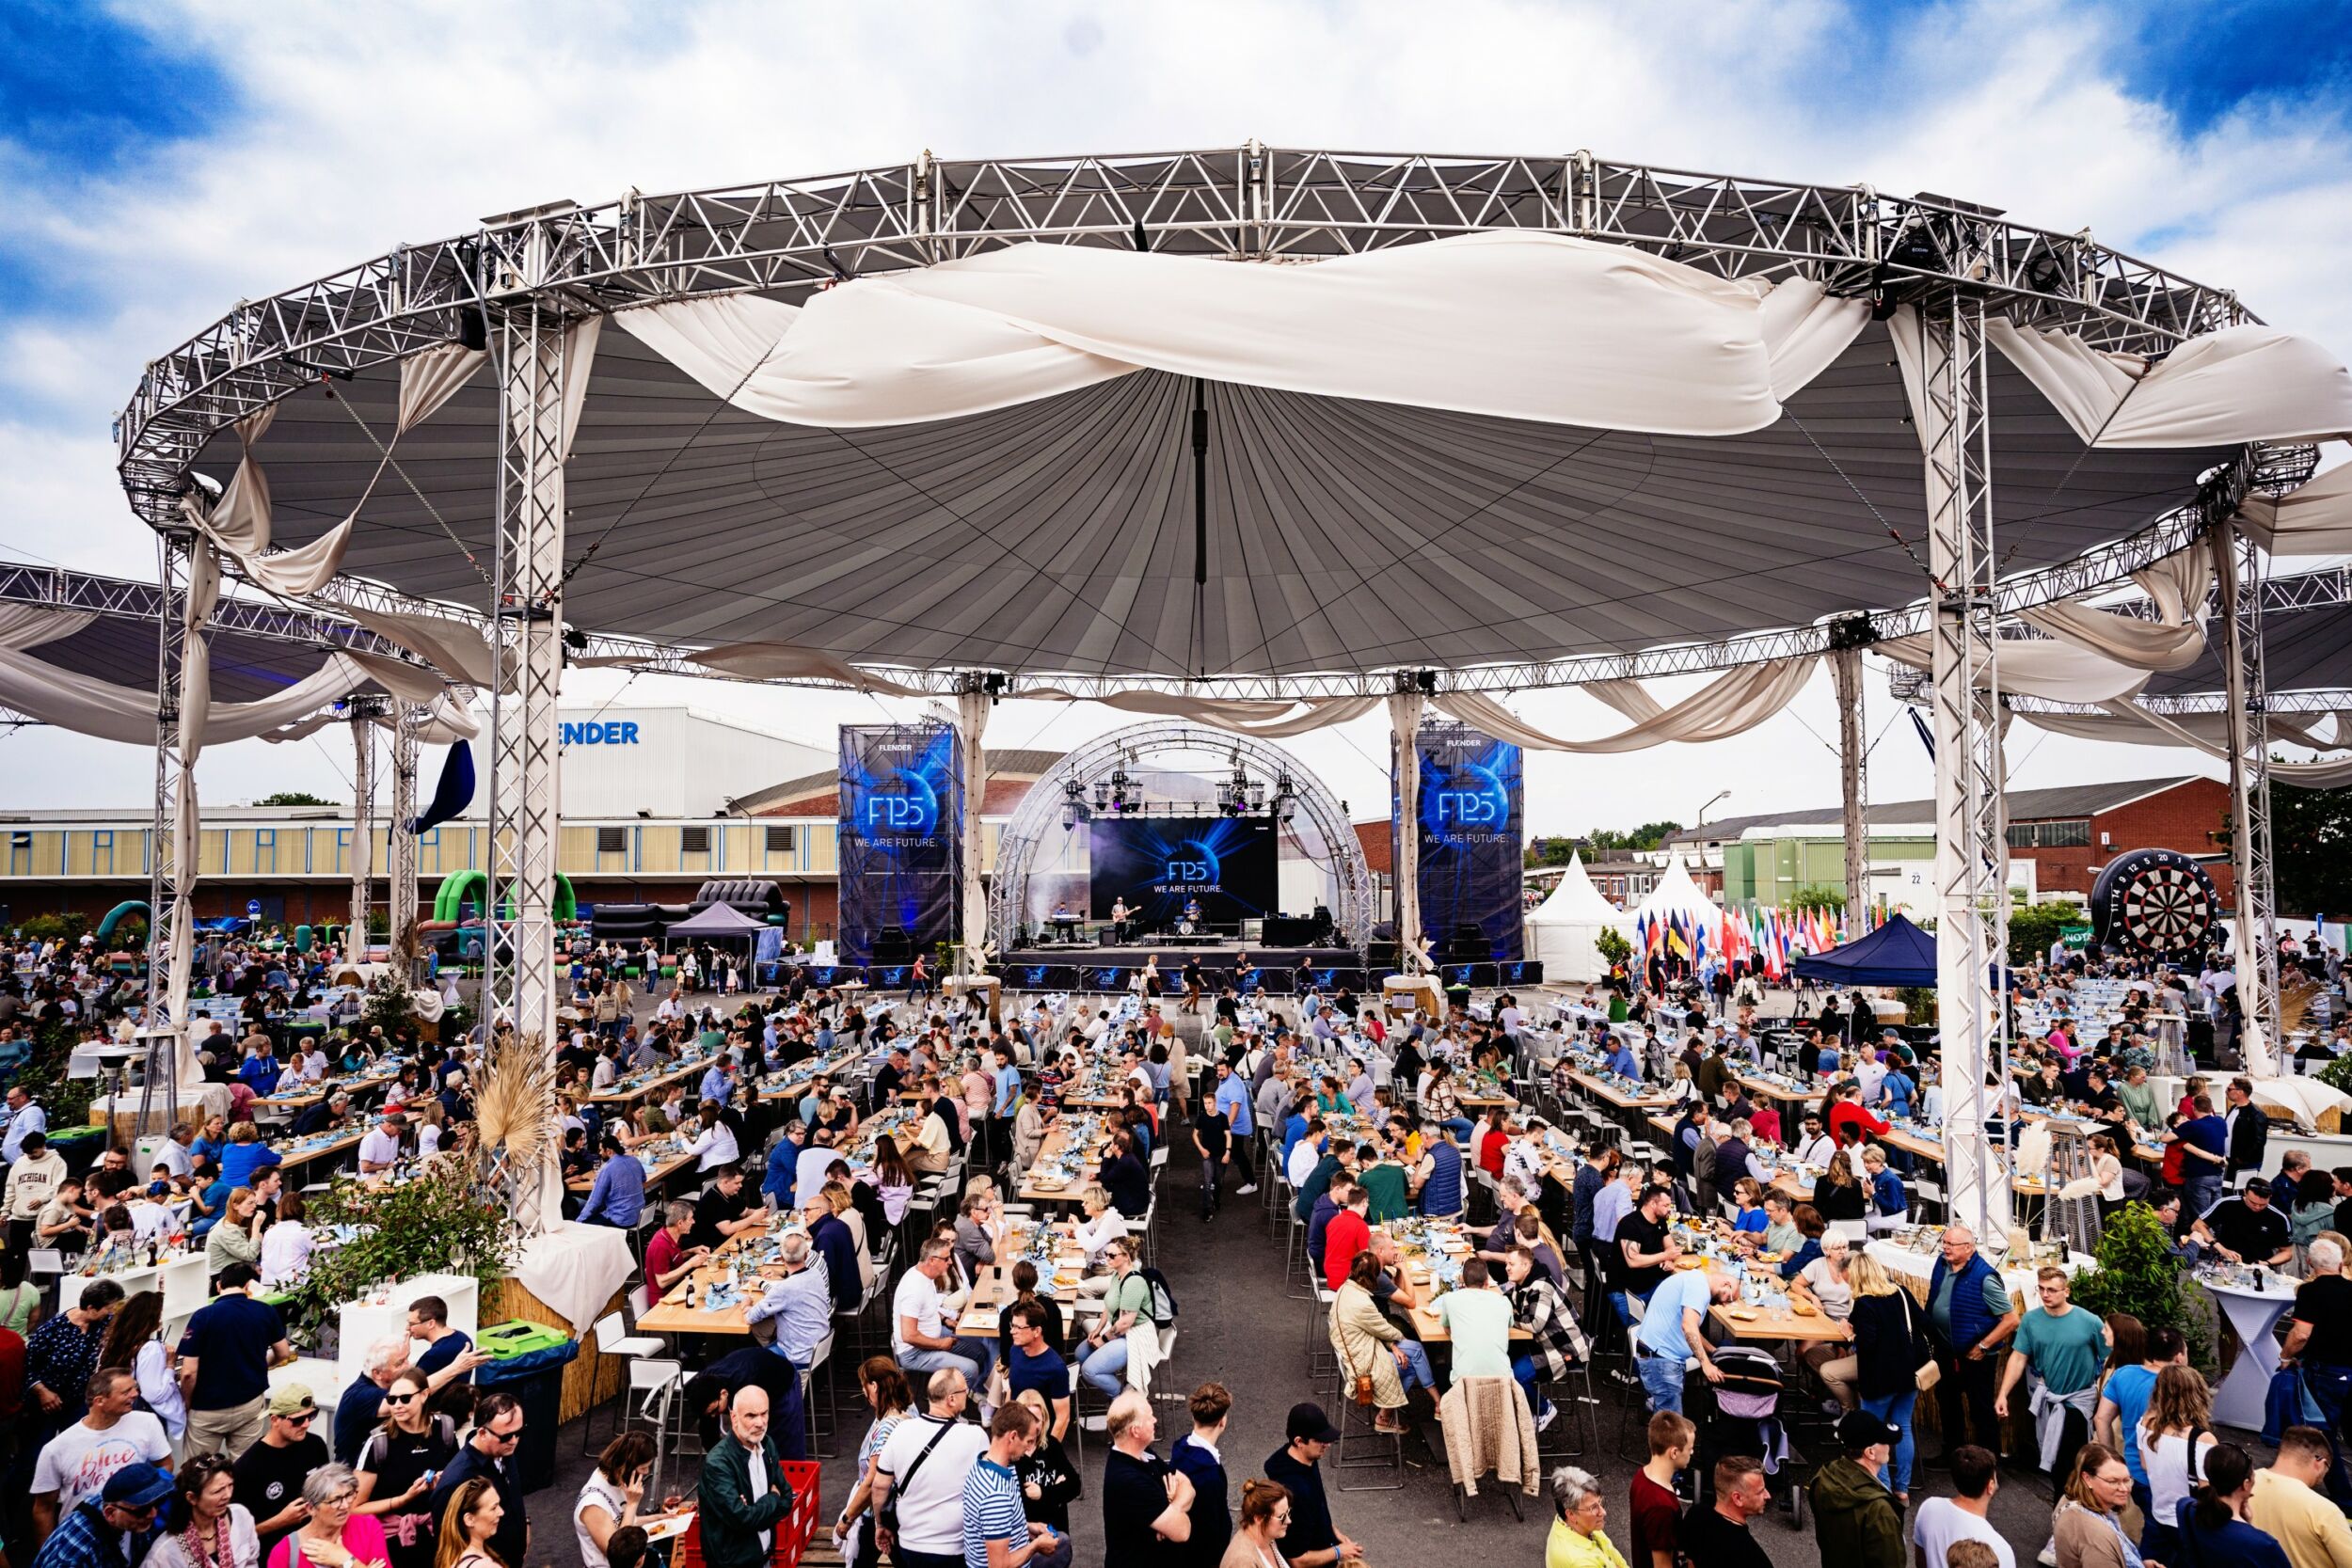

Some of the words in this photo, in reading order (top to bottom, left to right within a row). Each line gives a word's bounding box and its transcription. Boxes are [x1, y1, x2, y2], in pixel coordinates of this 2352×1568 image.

[558, 722, 639, 744] NDER
[854, 838, 869, 847] WE
[872, 838, 893, 847] ARE
[896, 837, 938, 847] FUTURE.
[1425, 834, 1440, 844] WE
[1443, 834, 1464, 843] ARE
[1468, 833, 1509, 843] FUTURE.
[2128, 863, 2139, 873] 12
[2189, 863, 2199, 873] 18
[1912, 875, 1920, 884] 22
[2112, 889, 2121, 898] 14
[2209, 889, 2217, 899] 13
[2110, 903, 2119, 911] 11
[2211, 921, 2218, 929] 10
[2119, 934, 2129, 944] 16
[2203, 934, 2212, 943] 15
[18, 1173, 47, 1185] MICHIGAN
[81, 1448, 136, 1477] Blue
